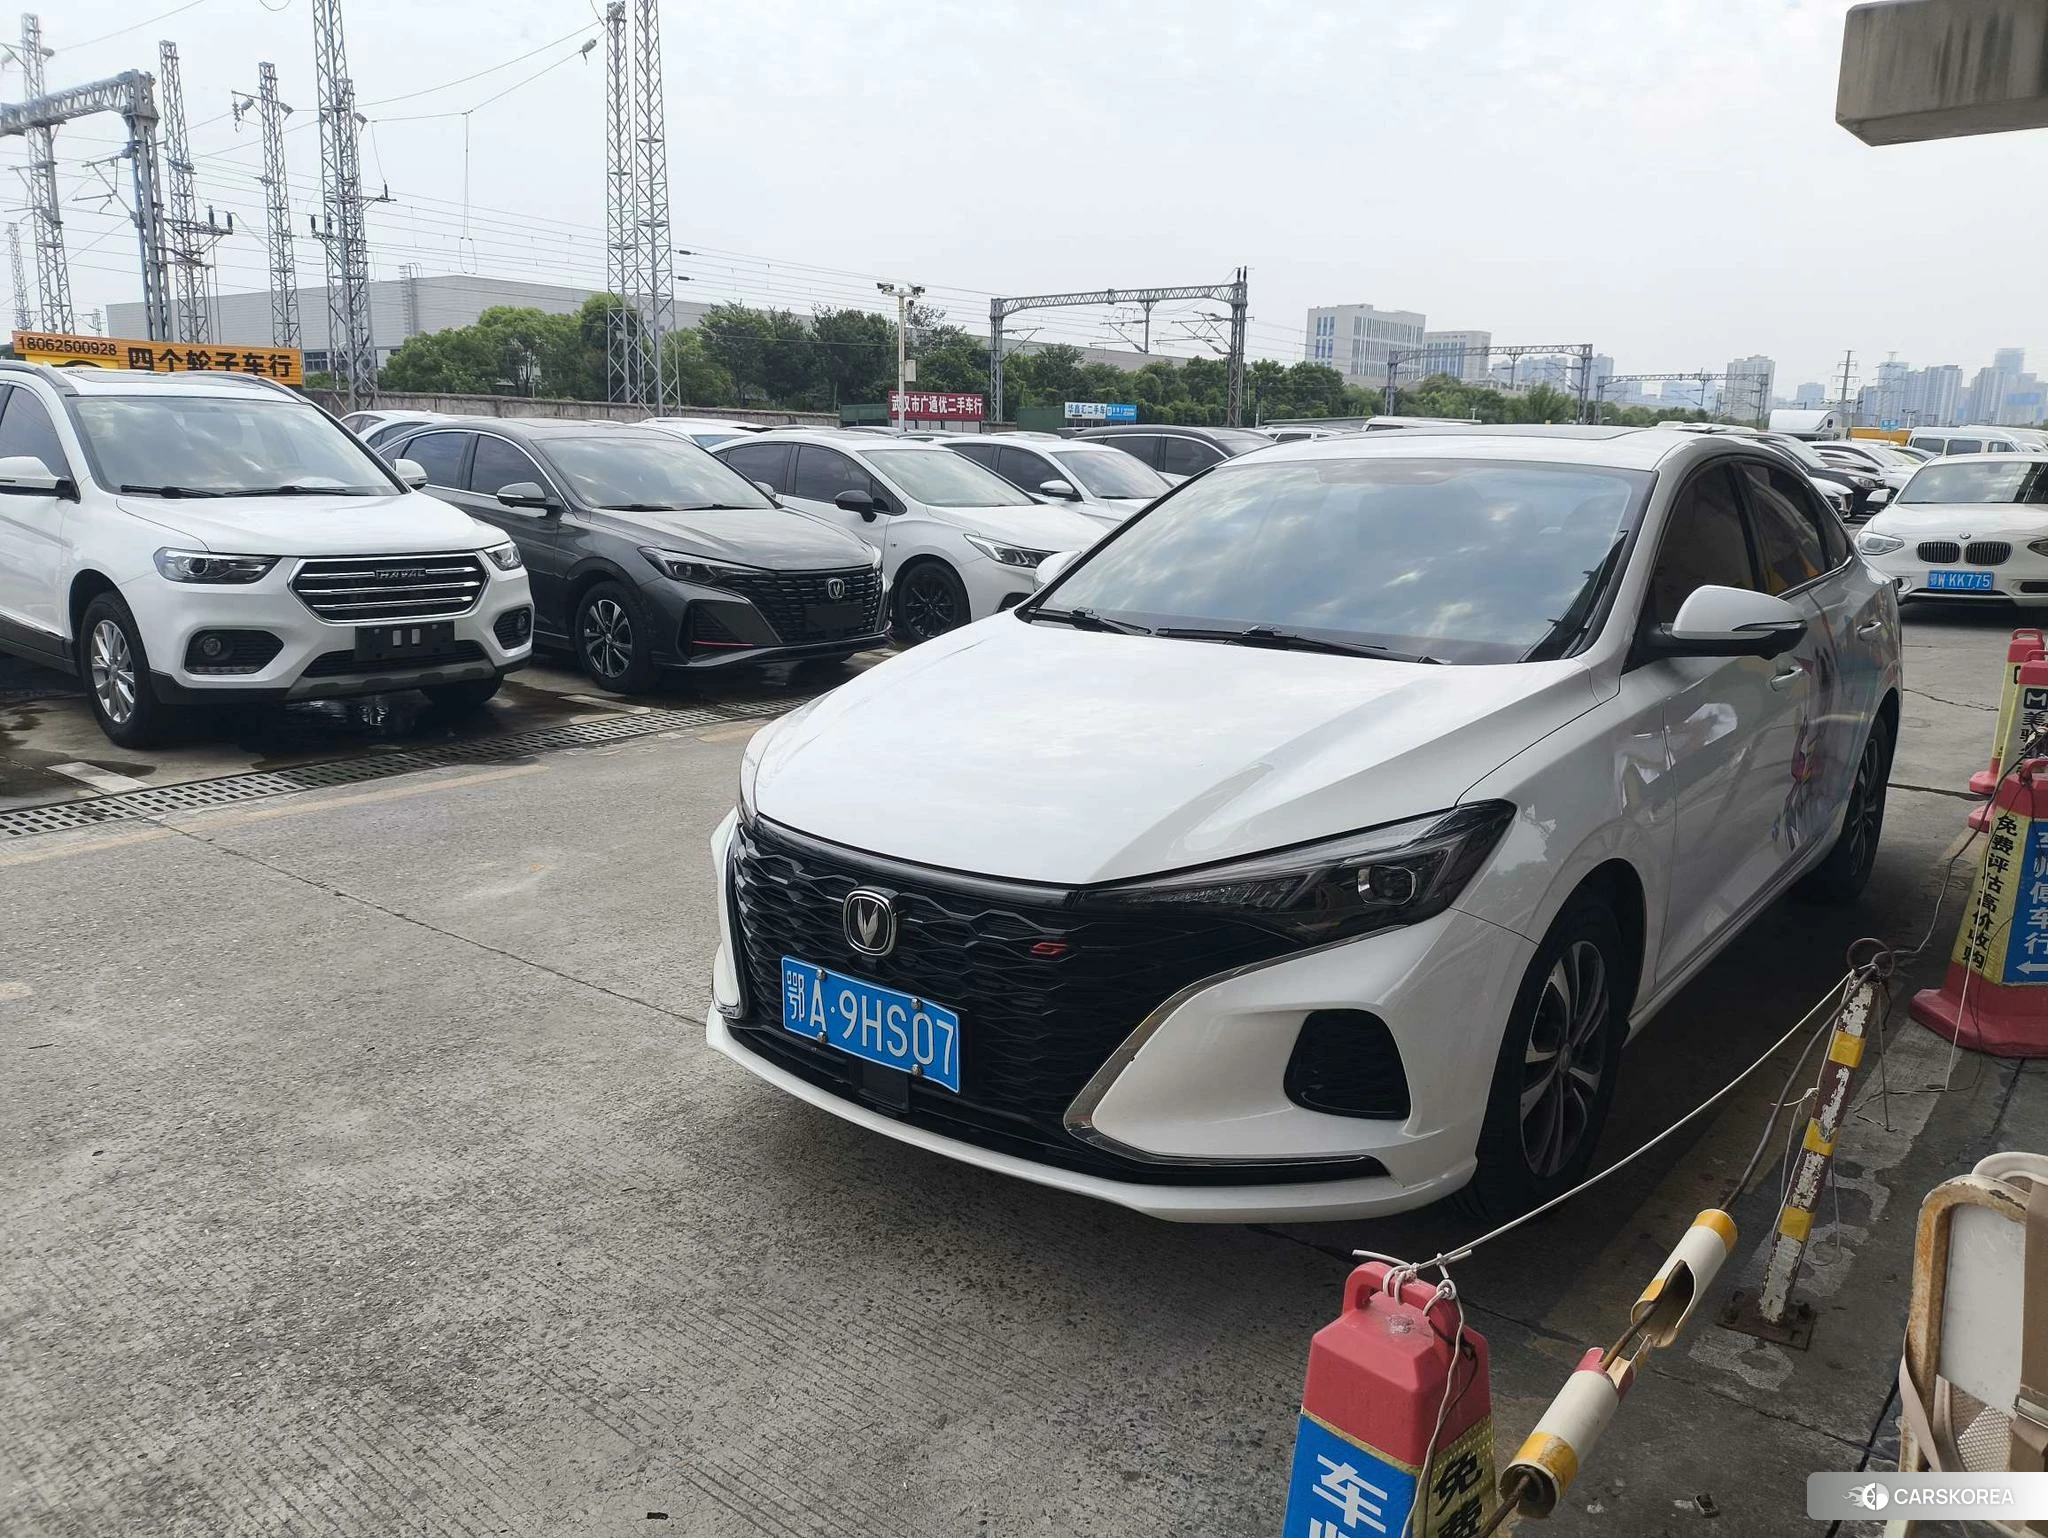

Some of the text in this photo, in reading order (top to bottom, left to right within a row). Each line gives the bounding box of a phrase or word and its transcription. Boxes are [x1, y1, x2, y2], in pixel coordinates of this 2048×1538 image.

[18, 336, 117, 356] 18062500928
[128, 346, 292, 377] 四个轮子车行
[1961, 815, 2018, 970] 免费评估高价收购
